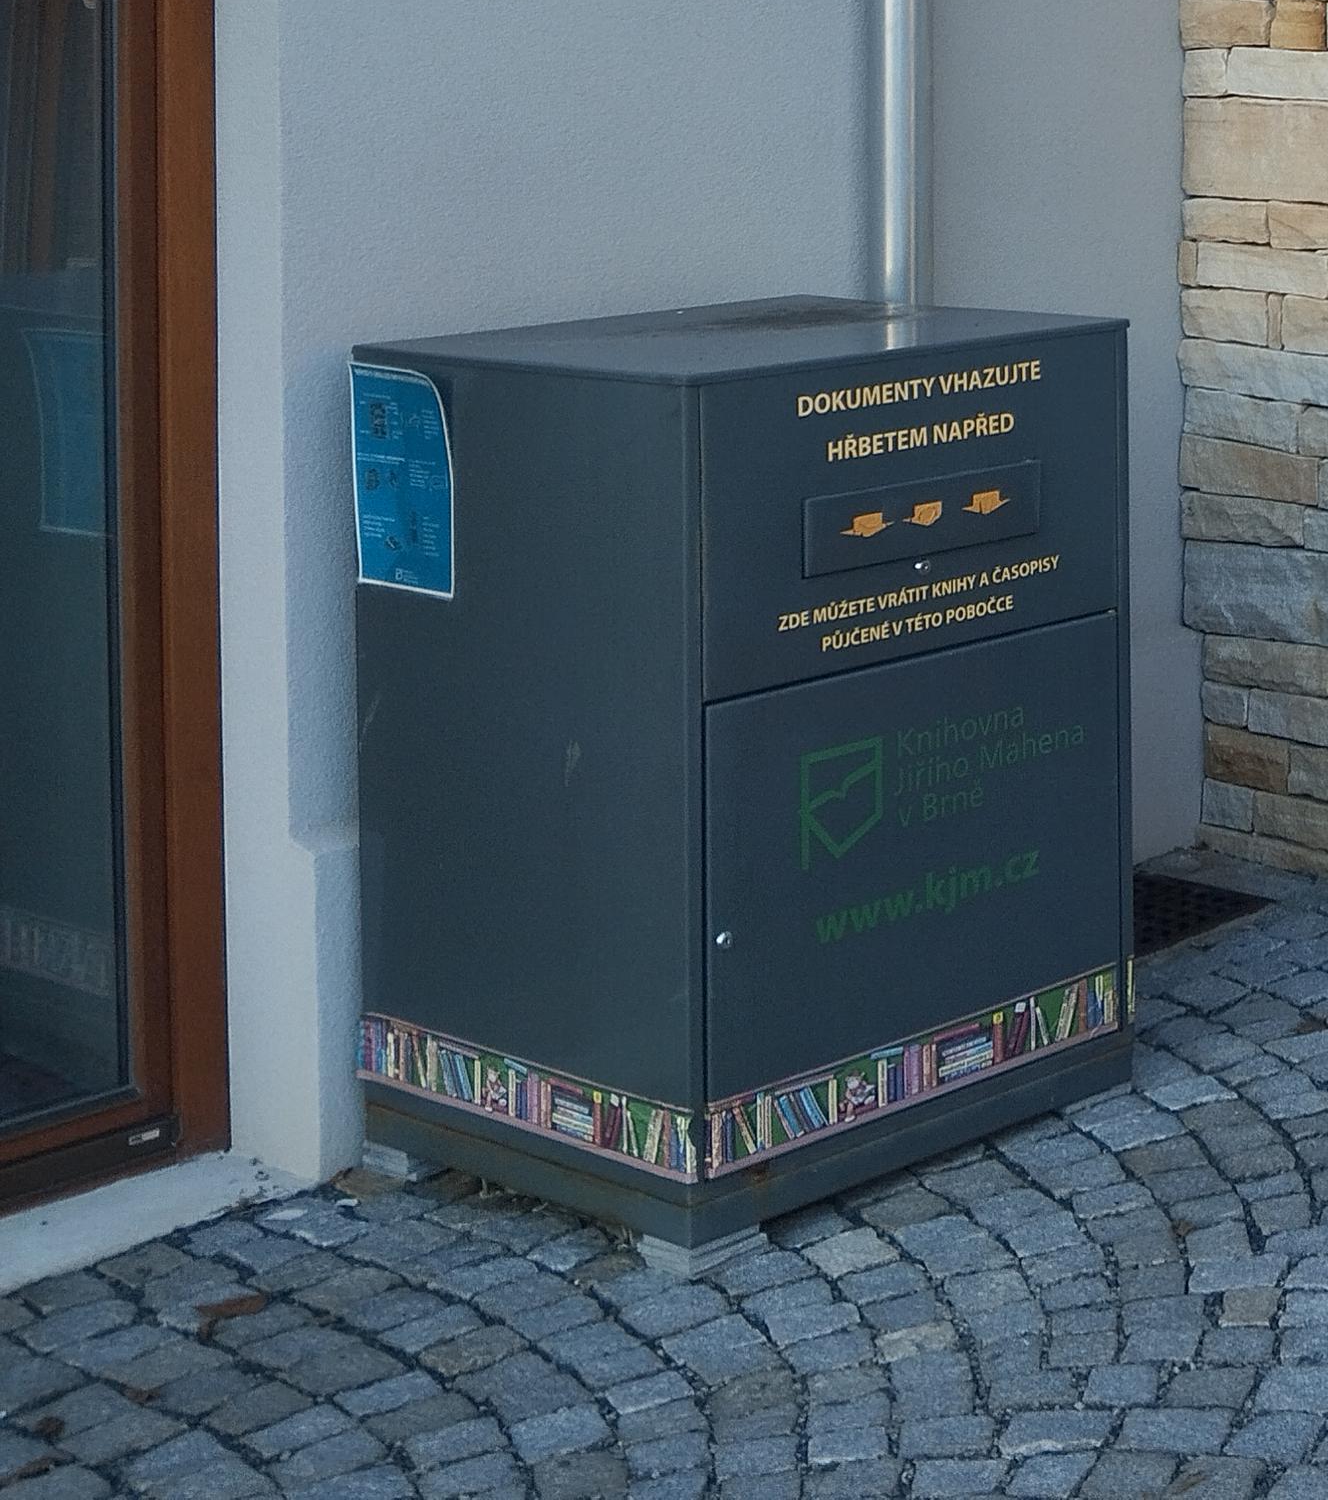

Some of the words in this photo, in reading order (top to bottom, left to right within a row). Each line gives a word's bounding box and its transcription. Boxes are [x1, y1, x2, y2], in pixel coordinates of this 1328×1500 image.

[796, 376, 936, 418] DOKUMENTY
[938, 360, 1042, 395] VHAZUJTE
[826, 426, 928, 463] HŘBETEM
[933, 411, 1015, 446] NAPŘED
[778, 611, 810, 632] ZDE
[812, 597, 876, 625] MŮŽETE
[877, 585, 929, 611] VRÁTIT
[931, 574, 977, 599] KNIHY
[979, 572, 990, 587] A
[991, 554, 1061, 585] ČASOPISY
[820, 622, 890, 653] PŮJČENÉ
[891, 620, 904, 637] V
[905, 611, 944, 634] TÉTO
[945, 595, 1015, 625] POBOČCE
[893, 756, 970, 797] Jiřího
[980, 723, 1085, 772] Mahena
[897, 705, 1025, 757] Knihovna
[899, 804, 913, 828] v
[922, 778, 985, 822] Brně
[815, 850, 1041, 945] www.kjm.cz
